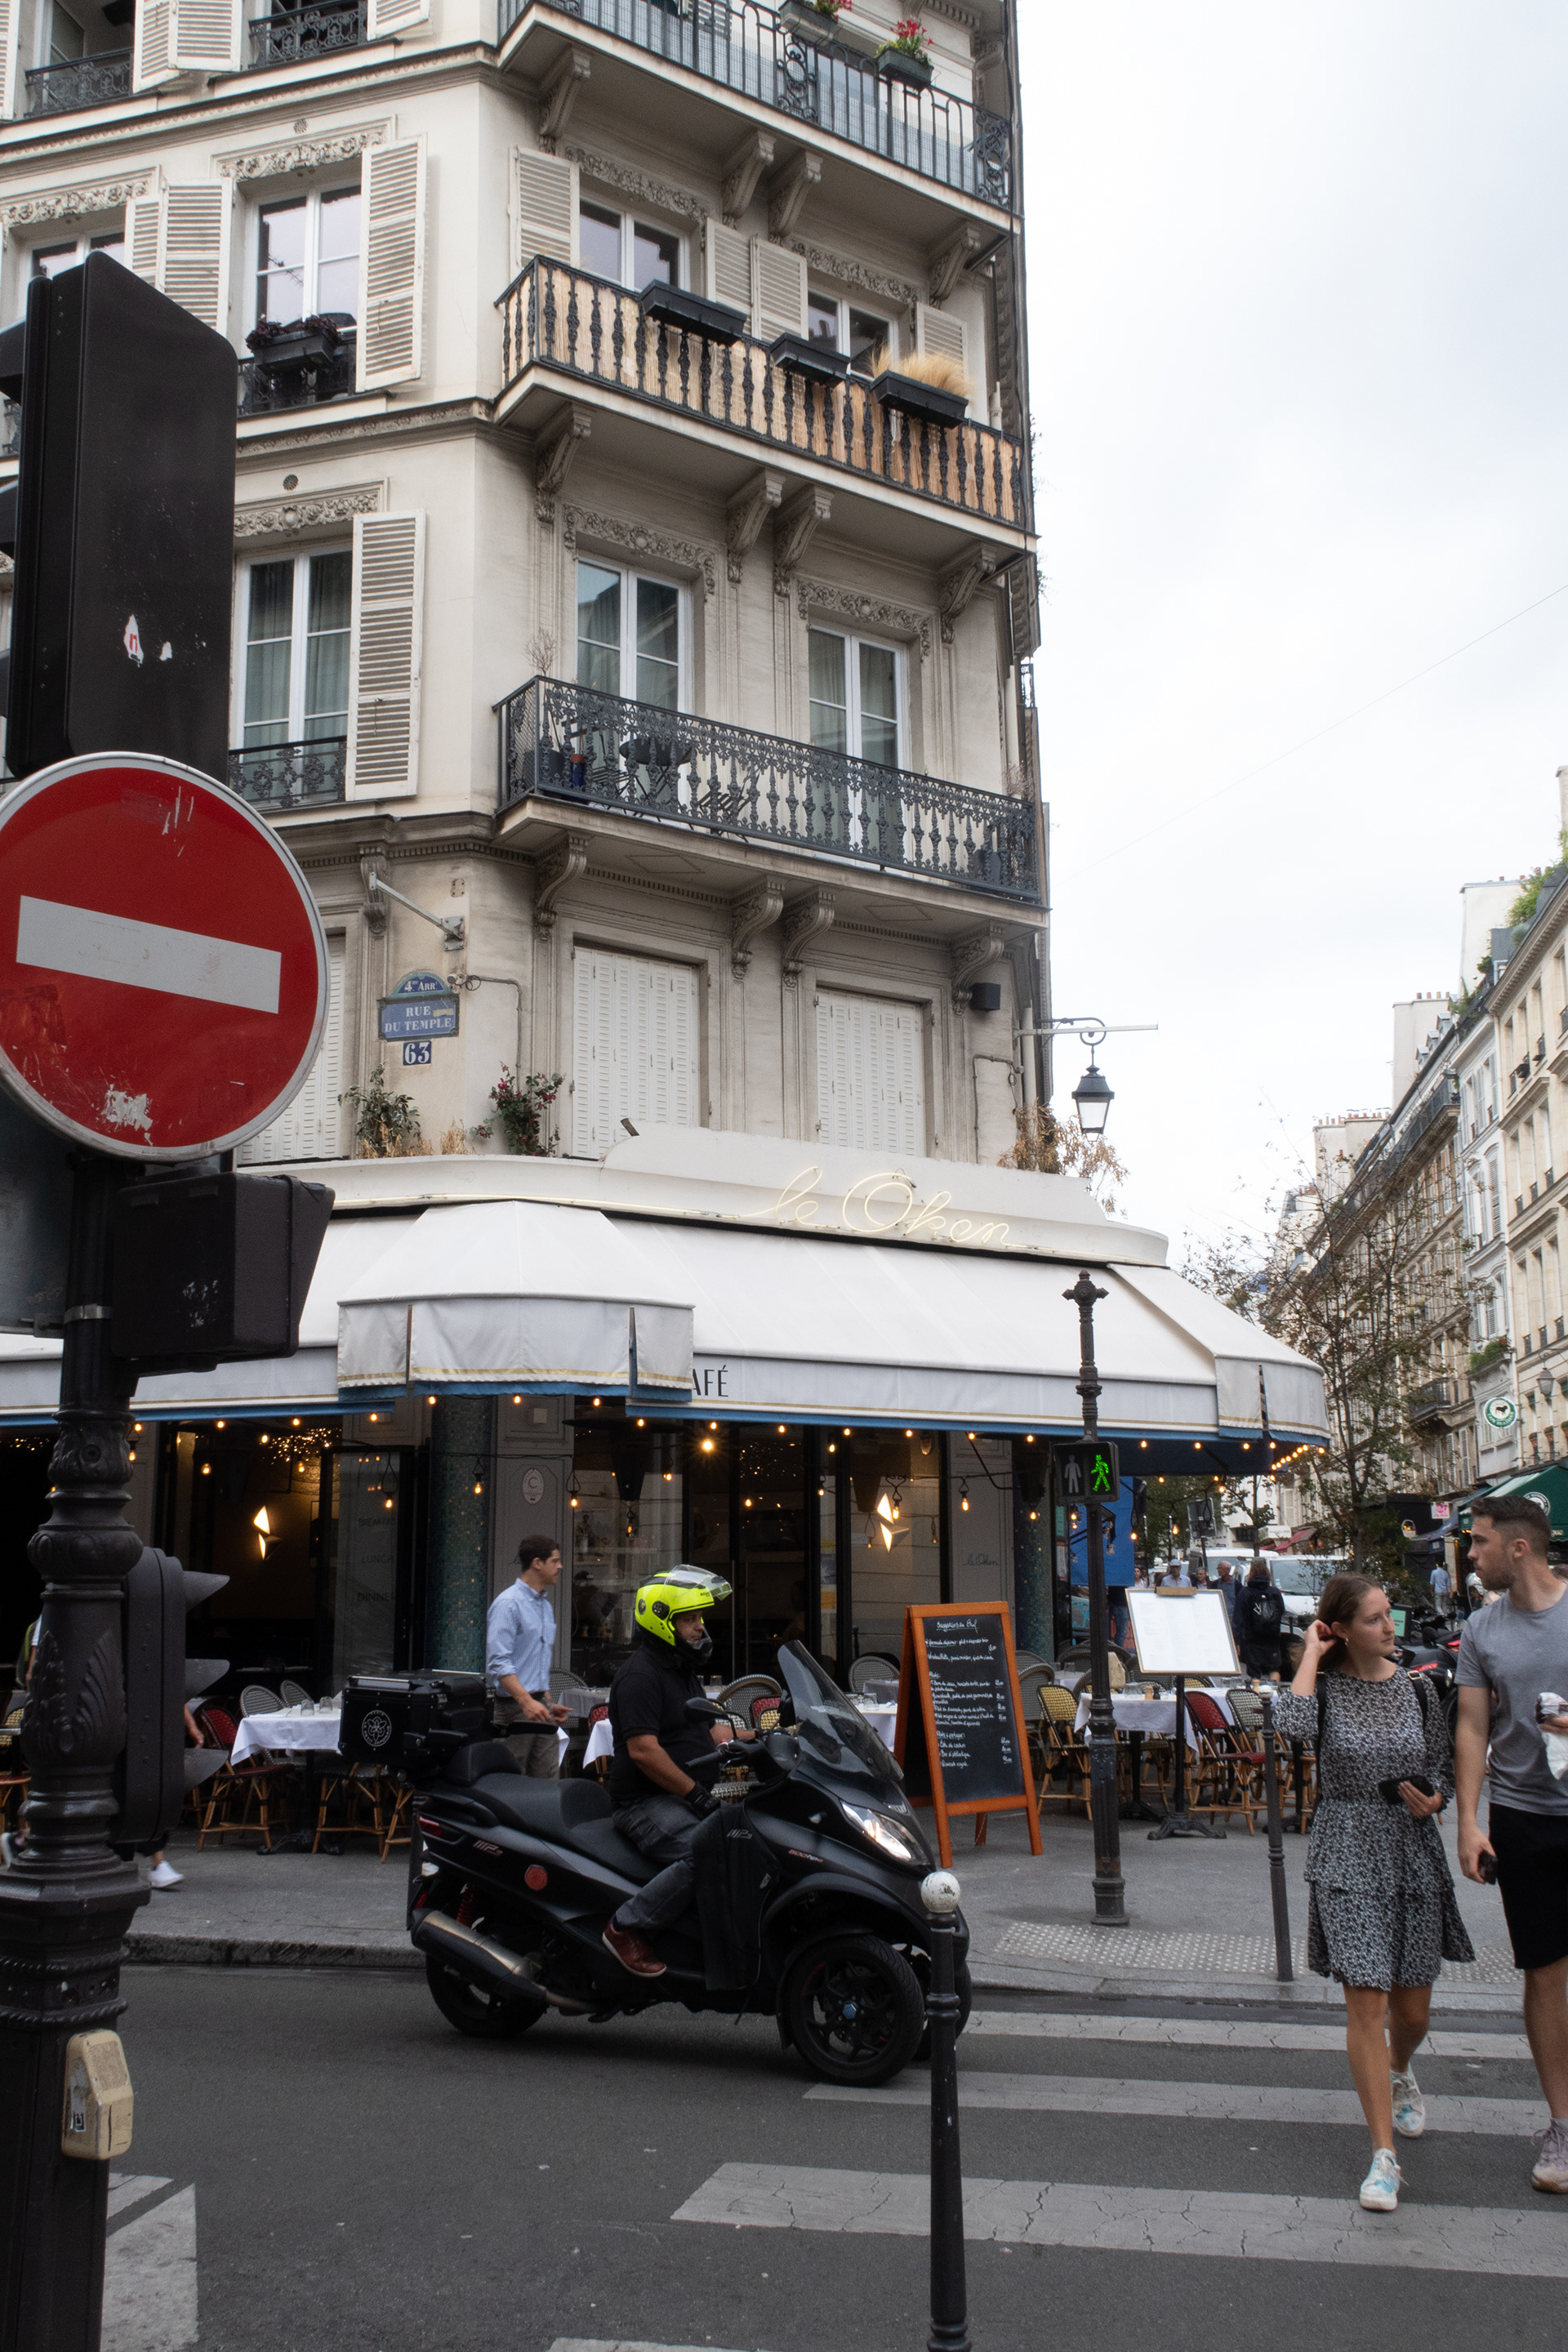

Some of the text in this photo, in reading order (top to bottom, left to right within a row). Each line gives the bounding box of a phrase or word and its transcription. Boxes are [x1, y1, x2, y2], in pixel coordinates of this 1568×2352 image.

[406, 1006, 430, 1017] RUE
[385, 1018, 452, 1032] DU TEMPLE
[405, 1042, 430, 1064] 63
[693, 1365, 728, 1397] AFÉ
[359, 1517, 397, 1527] BREAKFAS
[361, 1554, 394, 1564] LUNCH
